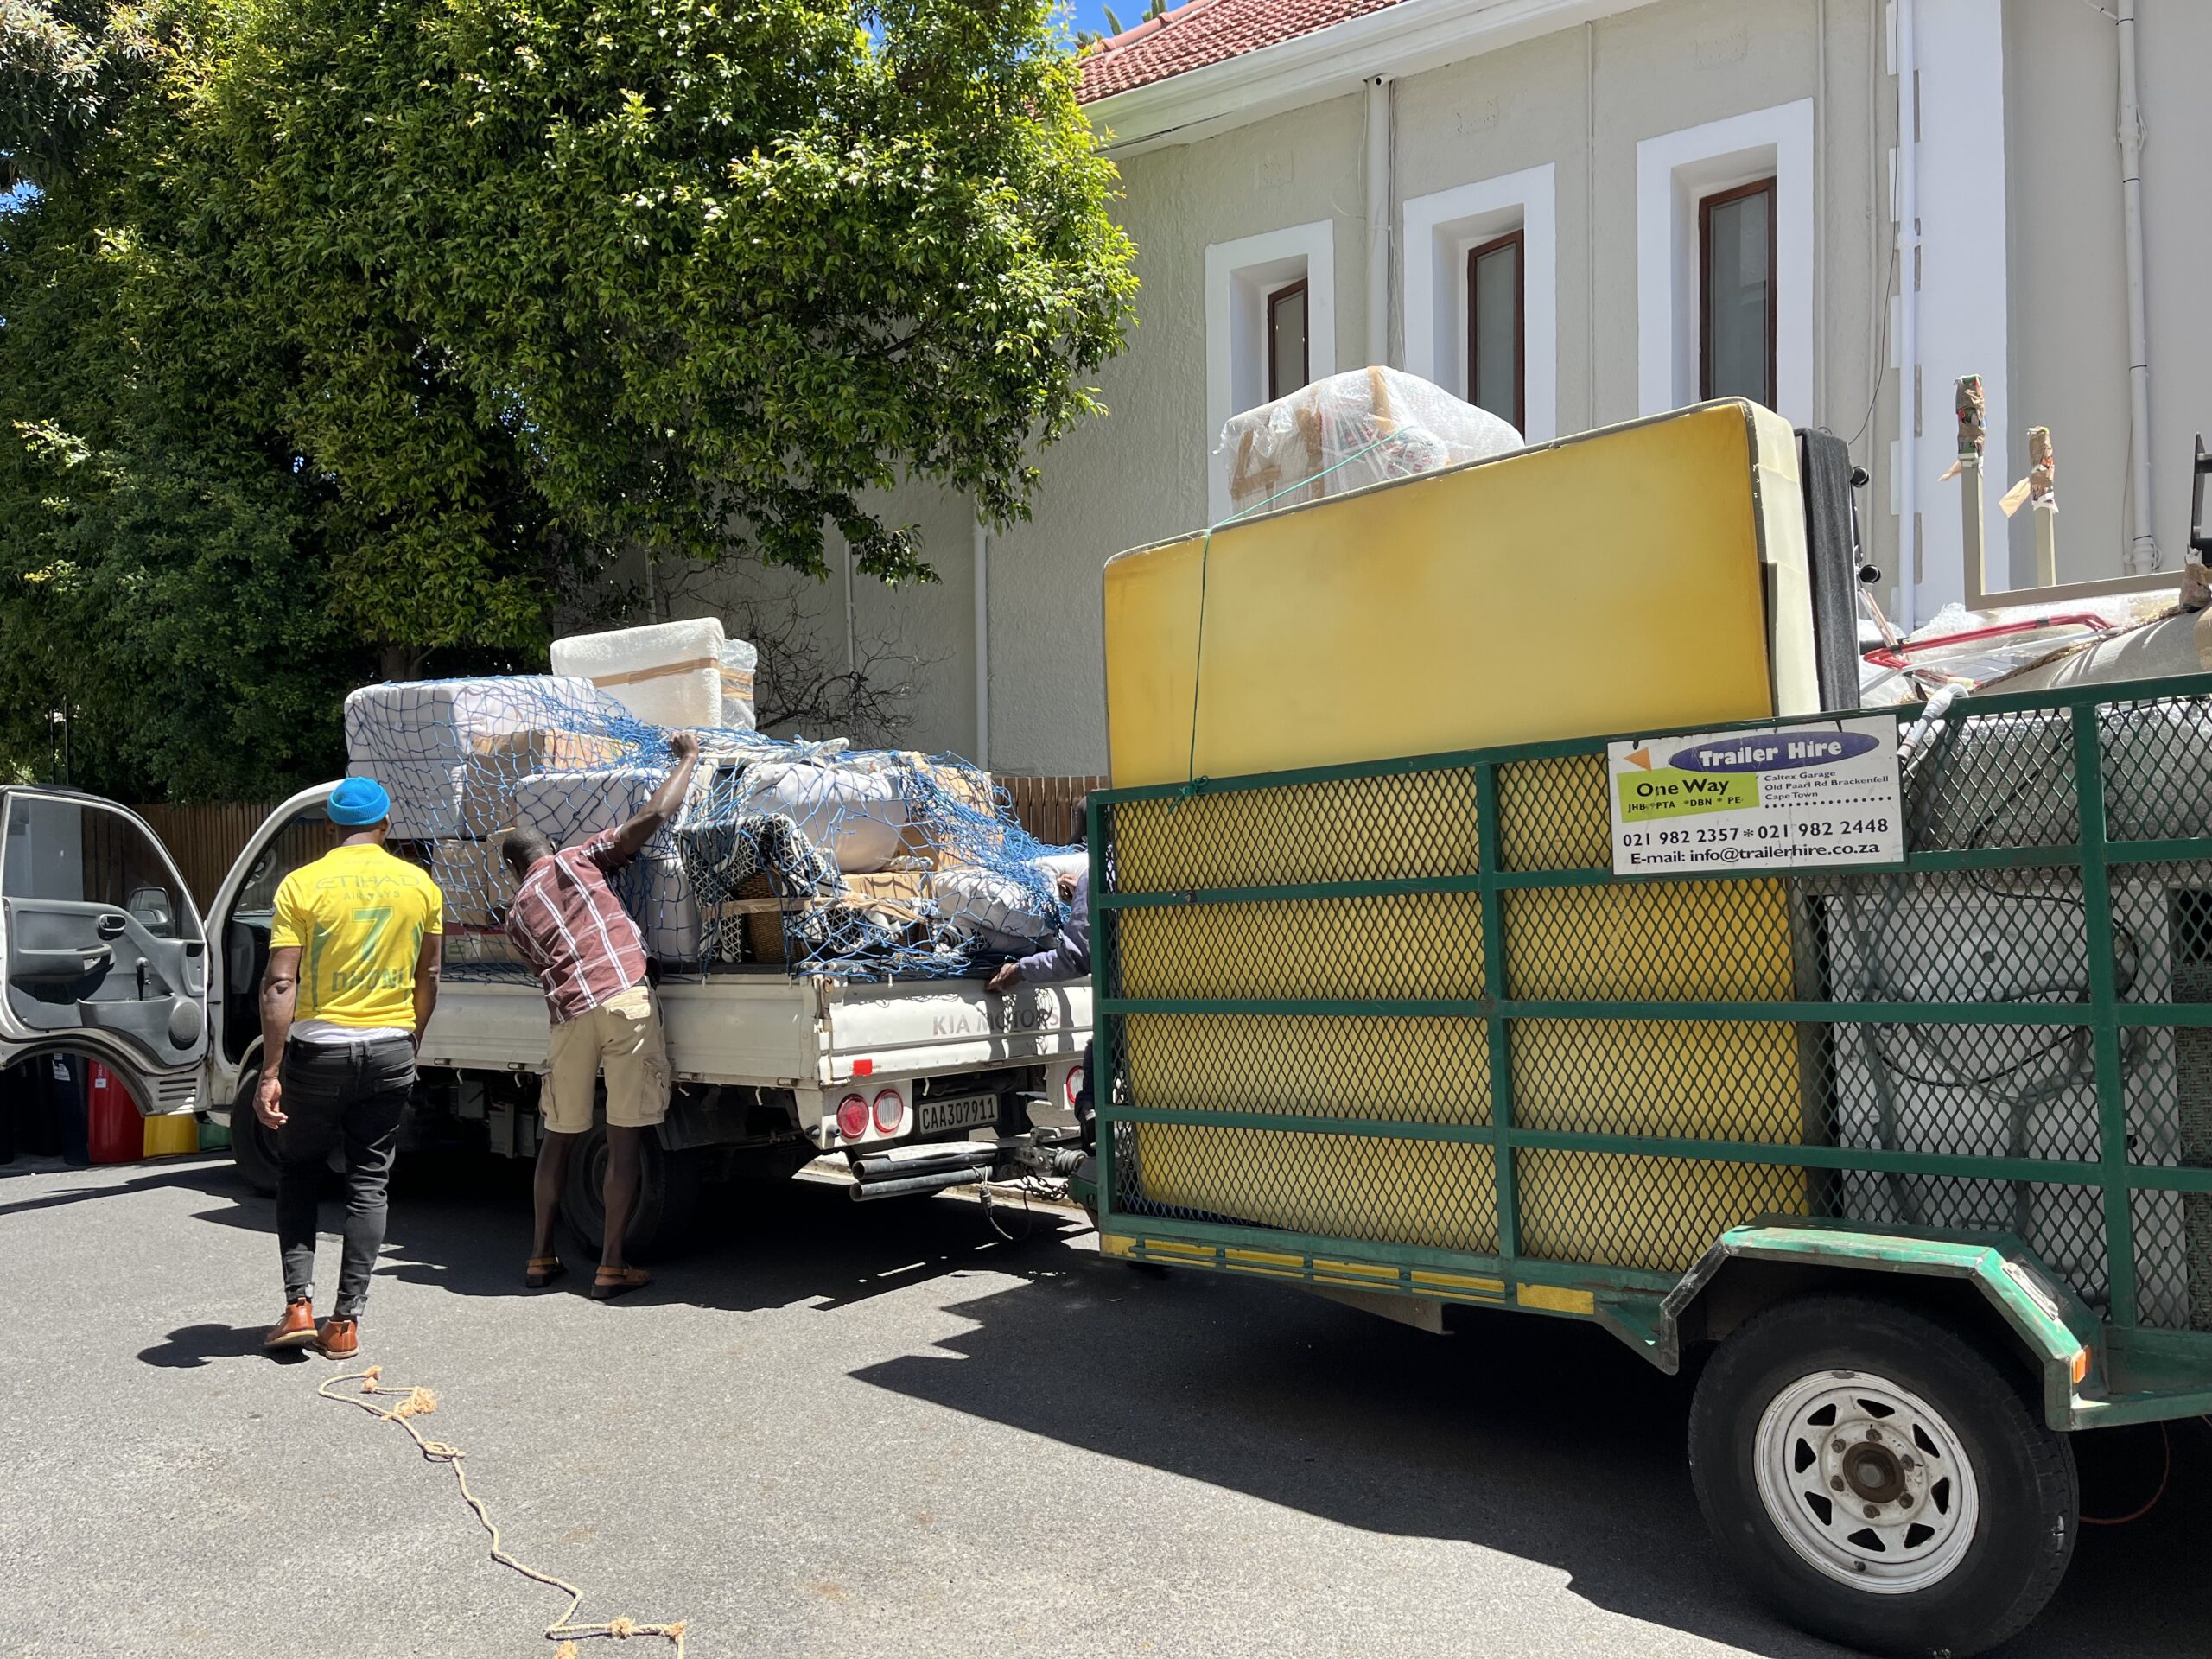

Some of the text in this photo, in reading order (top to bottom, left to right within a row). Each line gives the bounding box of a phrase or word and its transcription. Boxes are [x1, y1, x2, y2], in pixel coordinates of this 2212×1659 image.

[1699, 741, 1842, 767] Trailer Hire
[1799, 771, 1836, 780] Garage
[1830, 775, 1890, 787] Brackenfell
[1637, 778, 1729, 797] One Way
[1628, 803, 1647, 813] JHB
[1623, 832, 1650, 847] 021
[1659, 830, 1690, 845] 982
[1798, 822, 1833, 837] 982
[1840, 817, 1889, 835] 2448
[1630, 843, 1881, 864] E-mail: info@trailerhire.co.za
[316, 874, 420, 890] ETIHAD
[352, 906, 395, 963] 7
[932, 1008, 1060, 1036] KIA MOTOS
